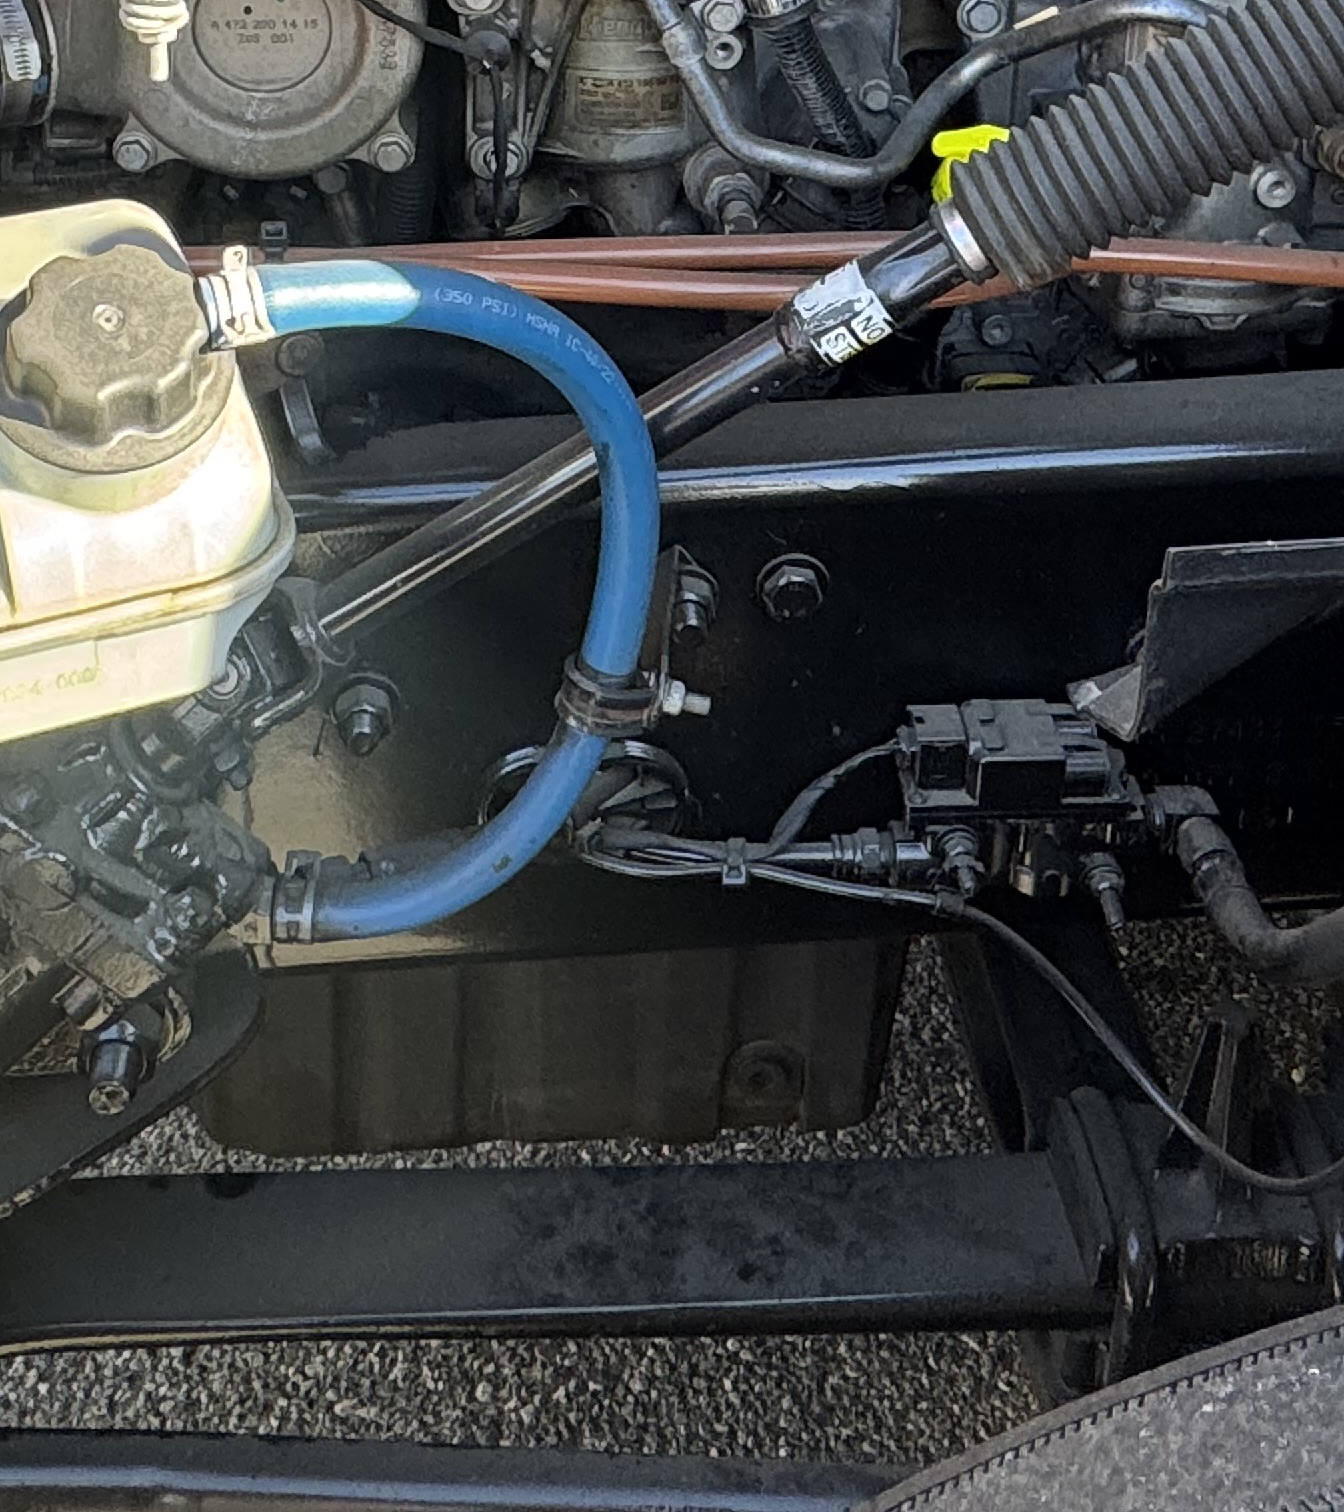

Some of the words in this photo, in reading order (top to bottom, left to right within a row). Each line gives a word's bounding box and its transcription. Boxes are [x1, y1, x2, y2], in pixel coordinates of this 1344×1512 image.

[434, 287, 473, 306] (350
[481, 296, 518, 318] PSI)
[526, 312, 561, 338] MSHA
